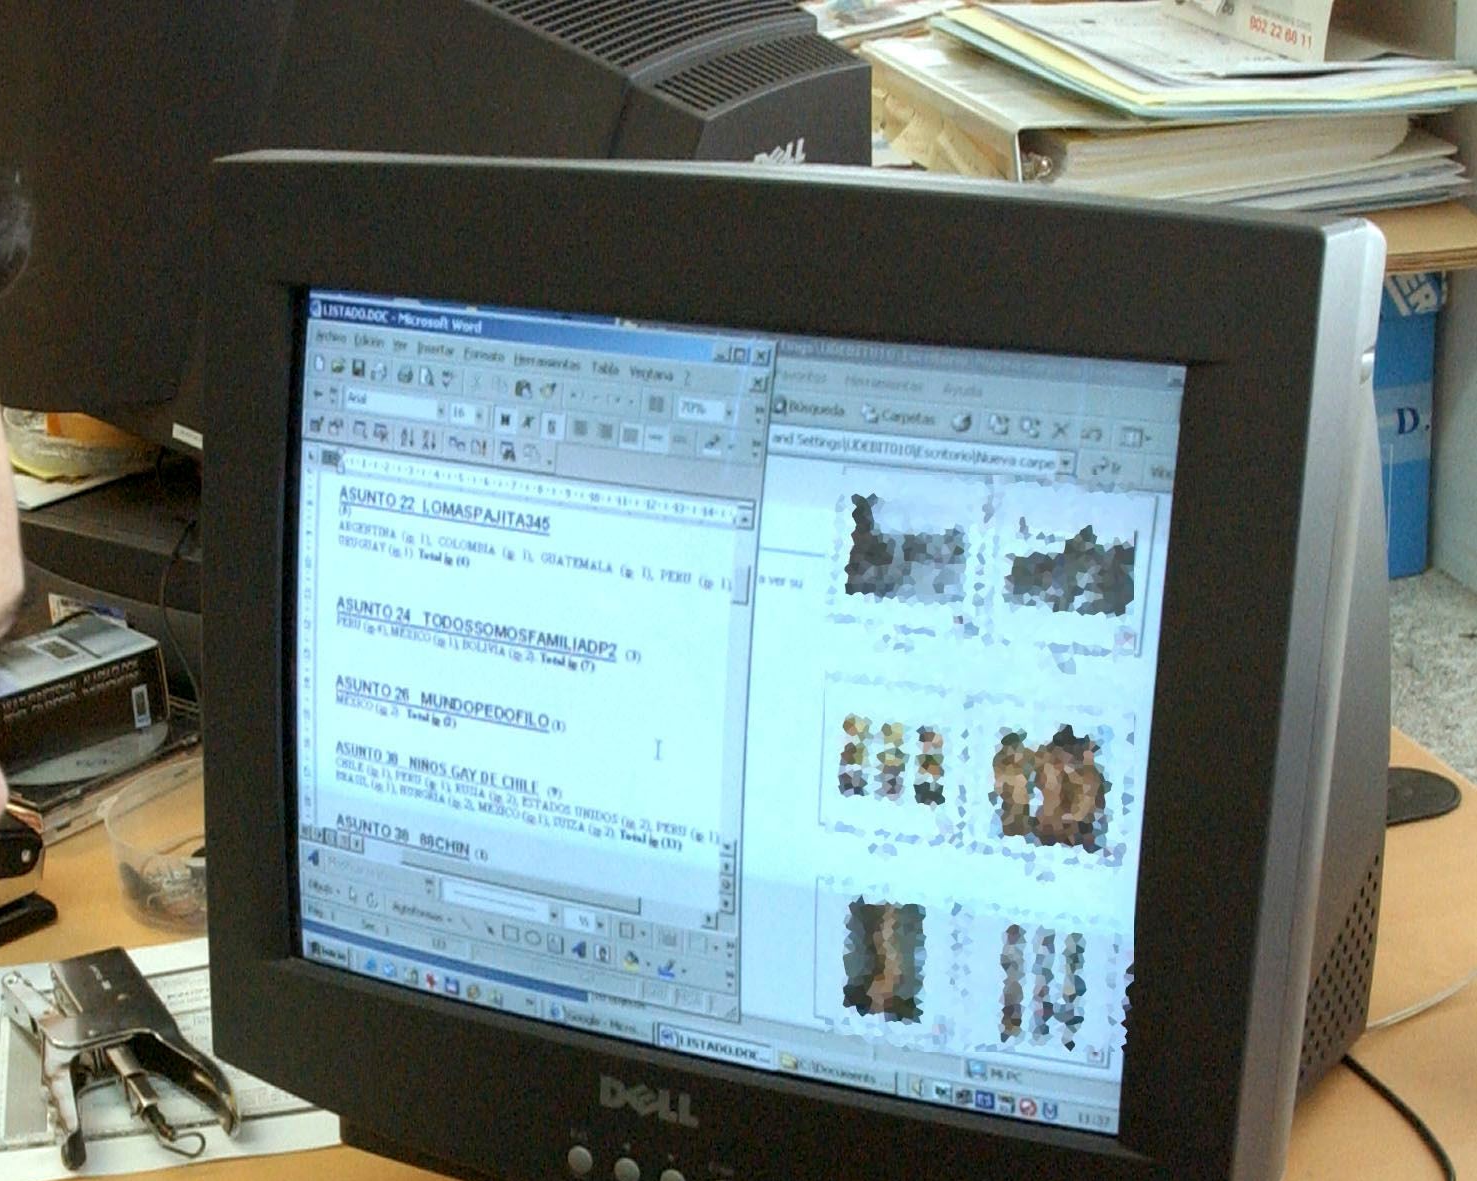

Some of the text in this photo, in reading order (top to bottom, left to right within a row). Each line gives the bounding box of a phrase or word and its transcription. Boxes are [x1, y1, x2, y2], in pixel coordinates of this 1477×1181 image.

[324, 305, 482, 333] LISTADO.DOC Microsoft Word
[340, 485, 397, 511] ASUNTO
[438, 536, 496, 556] COLOMBIA
[540, 551, 613, 574] GUATEMALA
[336, 595, 393, 620] ASUNTO
[335, 674, 392, 698] ASUNTO
[420, 691, 550, 729] MUNDOPEDOFILO
[336, 740, 382, 763] ASUNTO
[451, 764, 477, 782] GAY
[480, 770, 496, 786] DE
[502, 775, 537, 794] CHILE
[522, 796, 571, 816] ESTADOS
[574, 805, 618, 824] UNIDOS
[336, 813, 392, 838] ASUNTO
[600, 1073, 699, 1129] DELL
